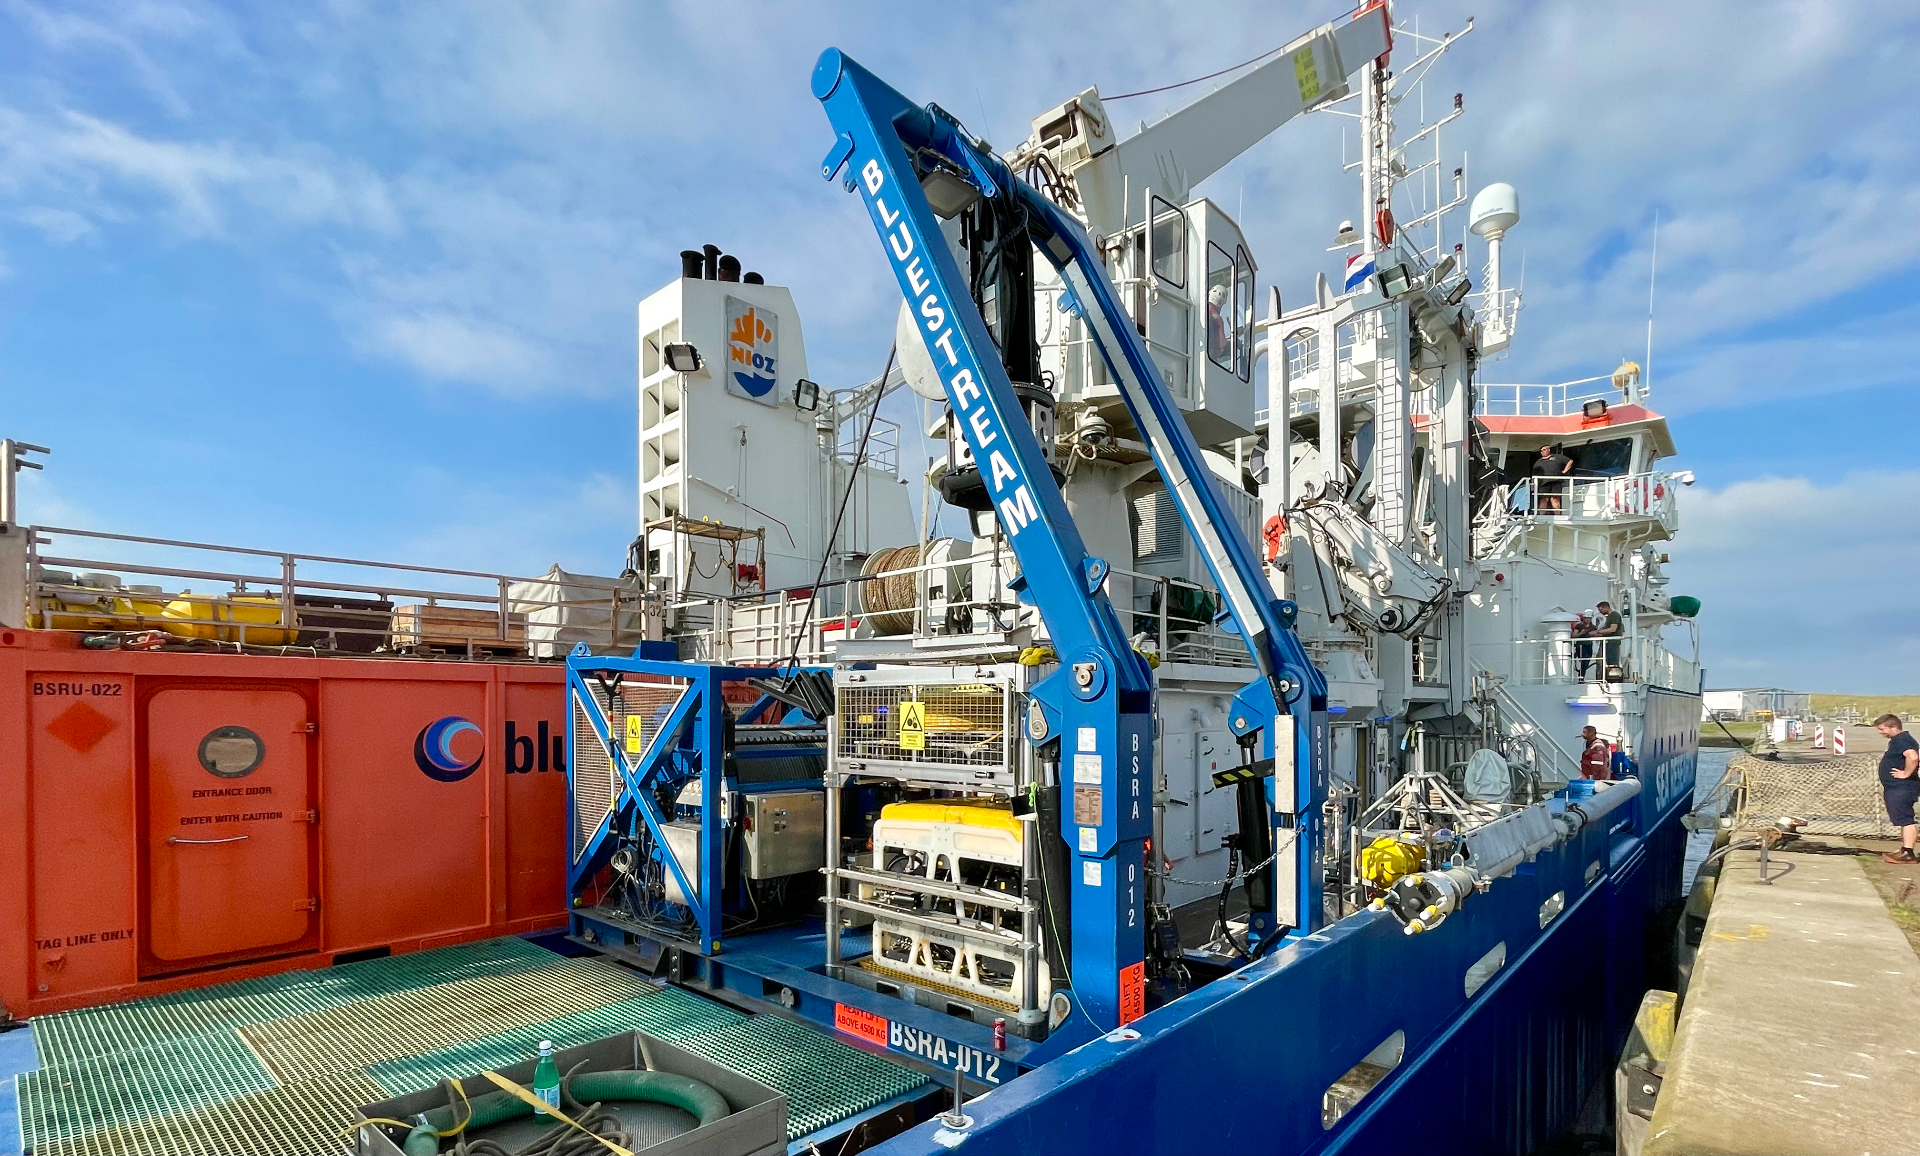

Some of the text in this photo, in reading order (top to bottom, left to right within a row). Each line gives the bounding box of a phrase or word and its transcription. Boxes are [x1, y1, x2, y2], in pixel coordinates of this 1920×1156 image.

[731, 345, 776, 374] NIOZ
[861, 158, 1039, 537] BLUESTREAM
[33, 682, 122, 696] BSRU-022
[504, 720, 567, 775] blu
[1131, 733, 1140, 820] BSRA
[192, 786, 272, 798] ENTRANCE DOOR
[180, 811, 283, 826] ENTER WITH CAUTION
[1128, 864, 1136, 927] 012
[35, 928, 134, 950] TAG LINE ONLY
[1132, 965, 1141, 984] KG
[837, 1013, 886, 1040] ABOVE 4500 KG
[890, 1020, 1000, 1084] BSRA-012
